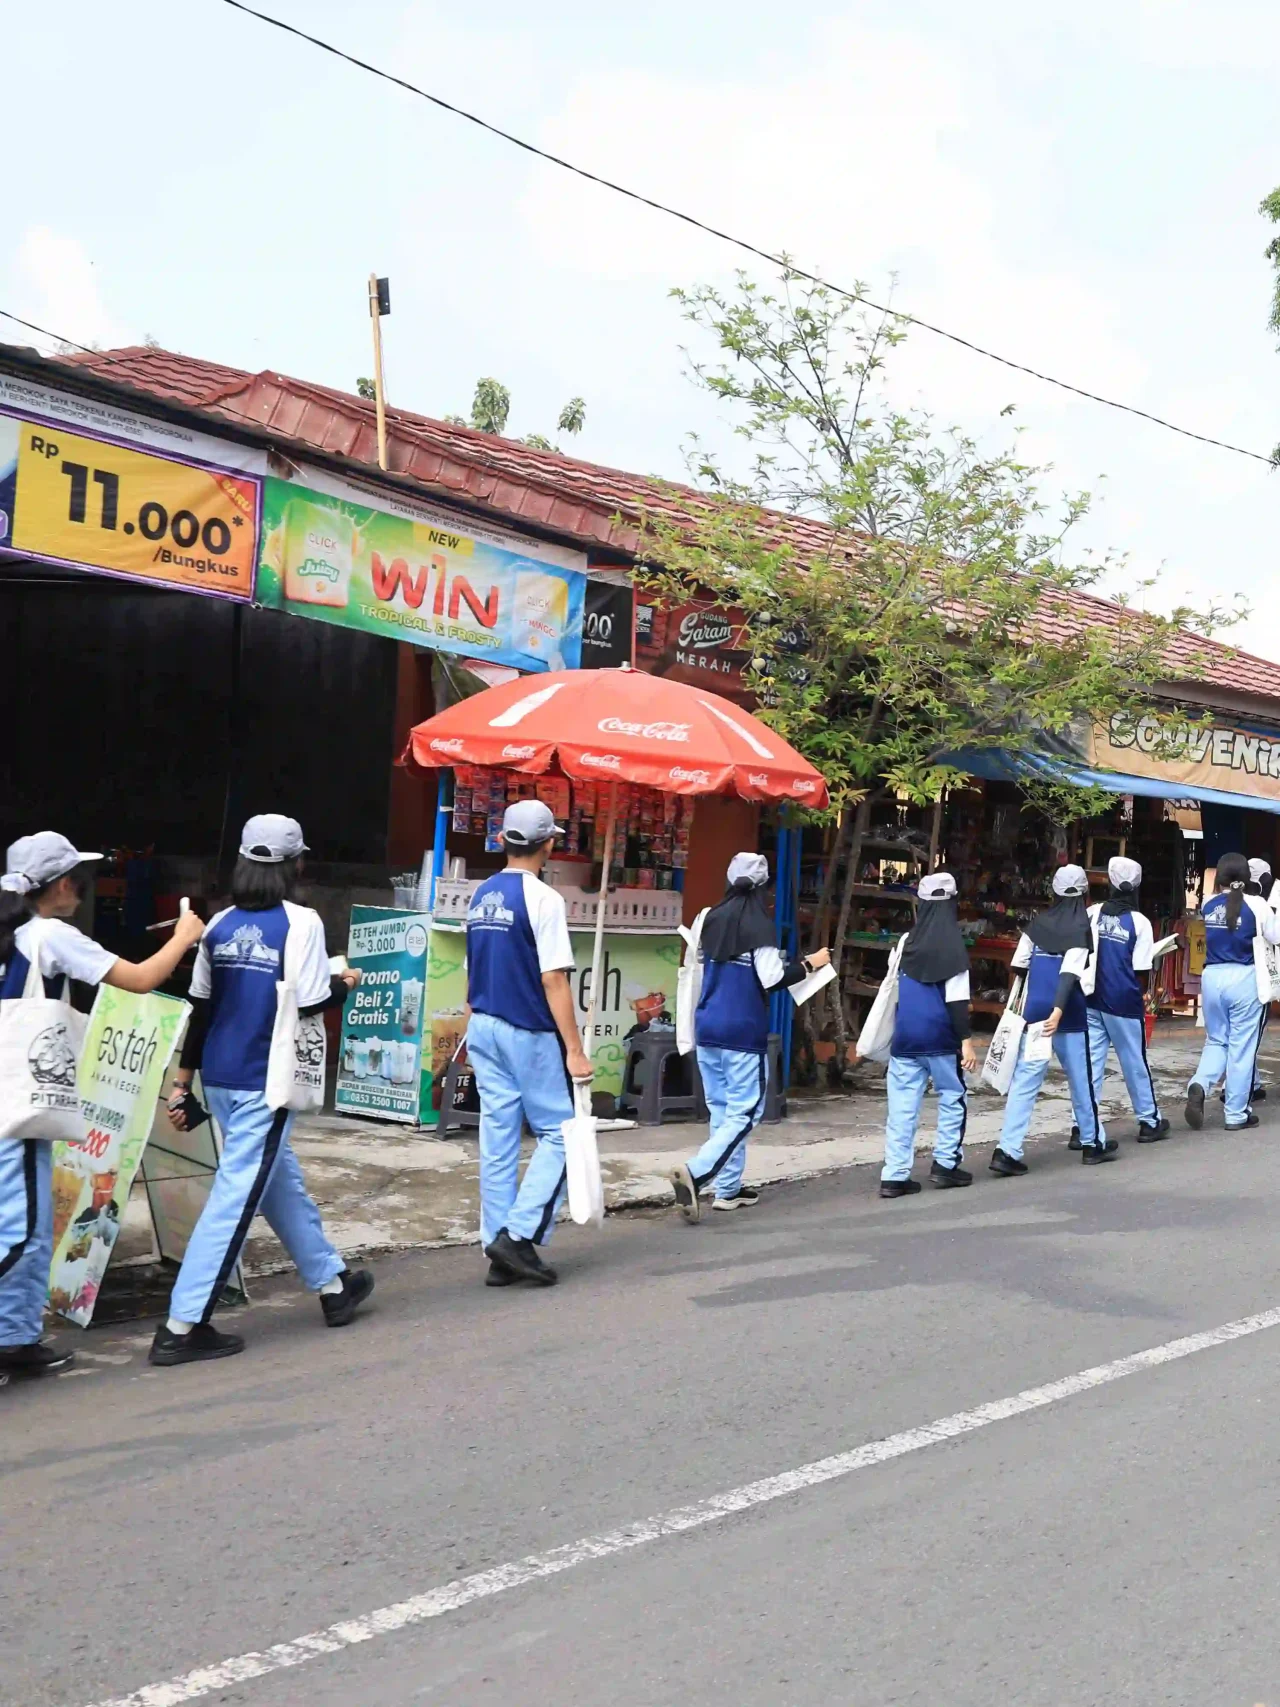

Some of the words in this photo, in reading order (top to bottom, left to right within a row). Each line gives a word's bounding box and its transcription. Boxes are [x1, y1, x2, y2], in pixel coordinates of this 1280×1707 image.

[30, 435, 60, 460] Rp
[308, 533, 337, 550] CLICK
[428, 530, 460, 549] NEW
[152, 546, 239, 578] /Bungkus
[298, 558, 340, 583] Juicy
[358, 603, 431, 632] TROPICAL
[435, 624, 446, 637] &
[447, 627, 502, 649] FROSTY
[700, 612, 728, 624] GUDANG
[678, 612, 732, 648] Garam
[676, 651, 731, 673] MERAH
[352, 928, 362, 939] ES
[363, 926, 377, 938] TEH
[378, 922, 407, 935] JUMBO
[367, 937, 396, 952] 3.000
[355, 991, 382, 1007] Beli
[384, 991, 394, 1007] 2
[347, 1009, 389, 1025] Gratis
[121, 1026, 158, 1075] teh
